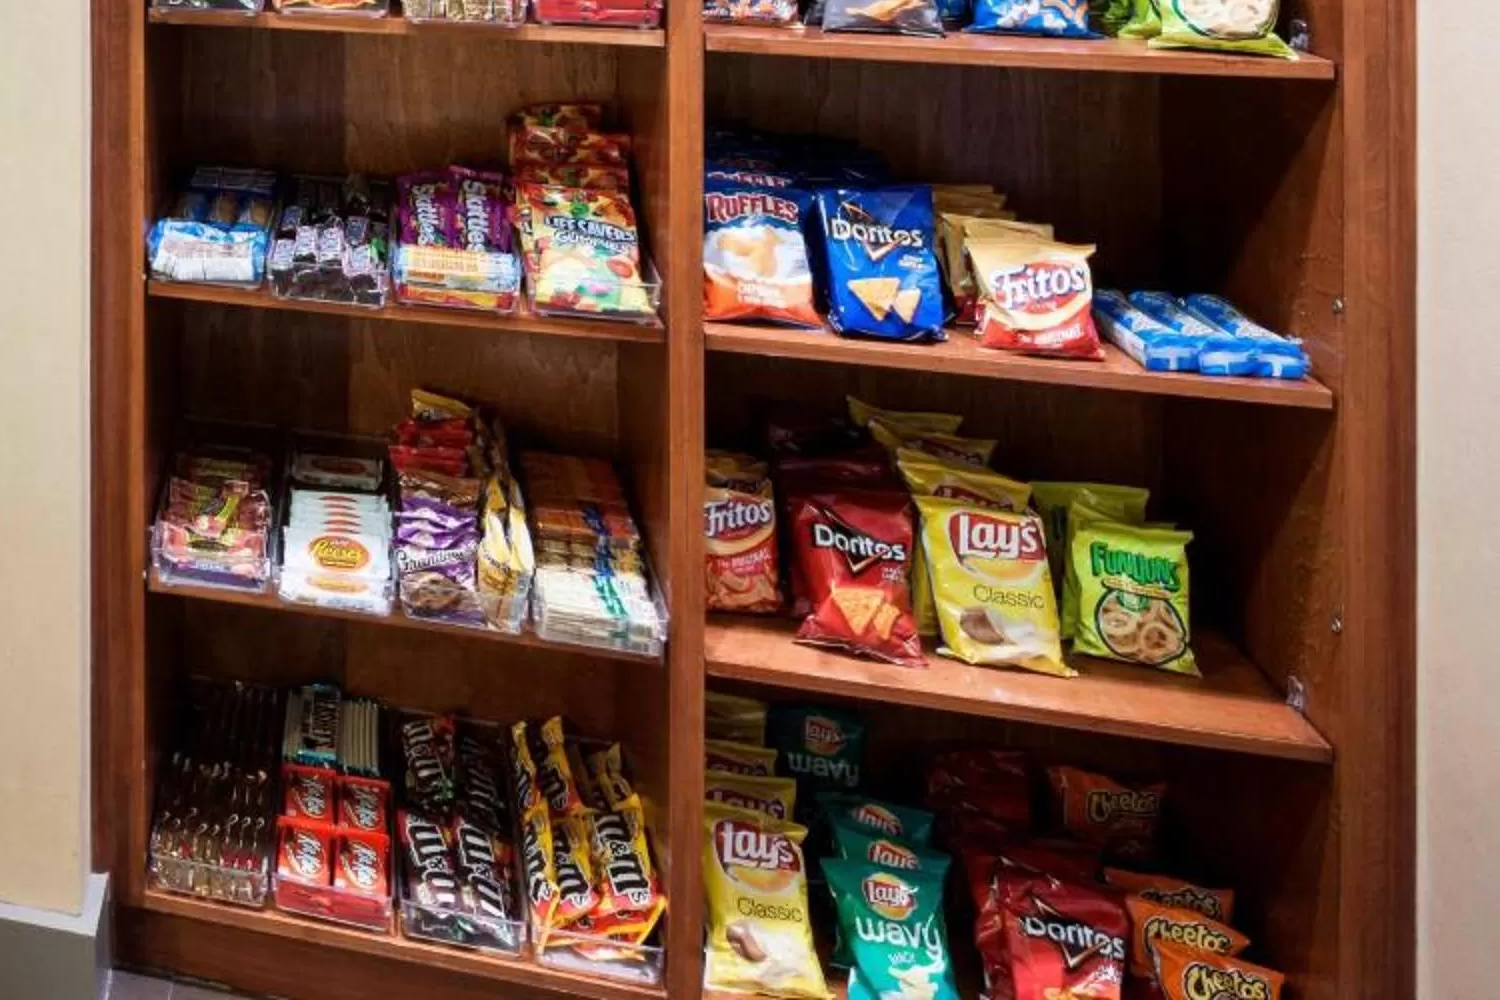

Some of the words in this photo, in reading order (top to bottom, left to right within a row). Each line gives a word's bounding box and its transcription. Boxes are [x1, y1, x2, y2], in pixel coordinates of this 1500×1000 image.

[706, 192, 799, 223] RUFFLES
[831, 218, 923, 247] Doritos
[989, 264, 1088, 309] Fritos
[813, 523, 905, 561] Doritos
[959, 513, 1038, 560] Lay's
[972, 585, 1045, 609] Classic
[722, 822, 795, 870] Lay's
[738, 897, 803, 921] Classic
[1021, 917, 1125, 959] Doritos
